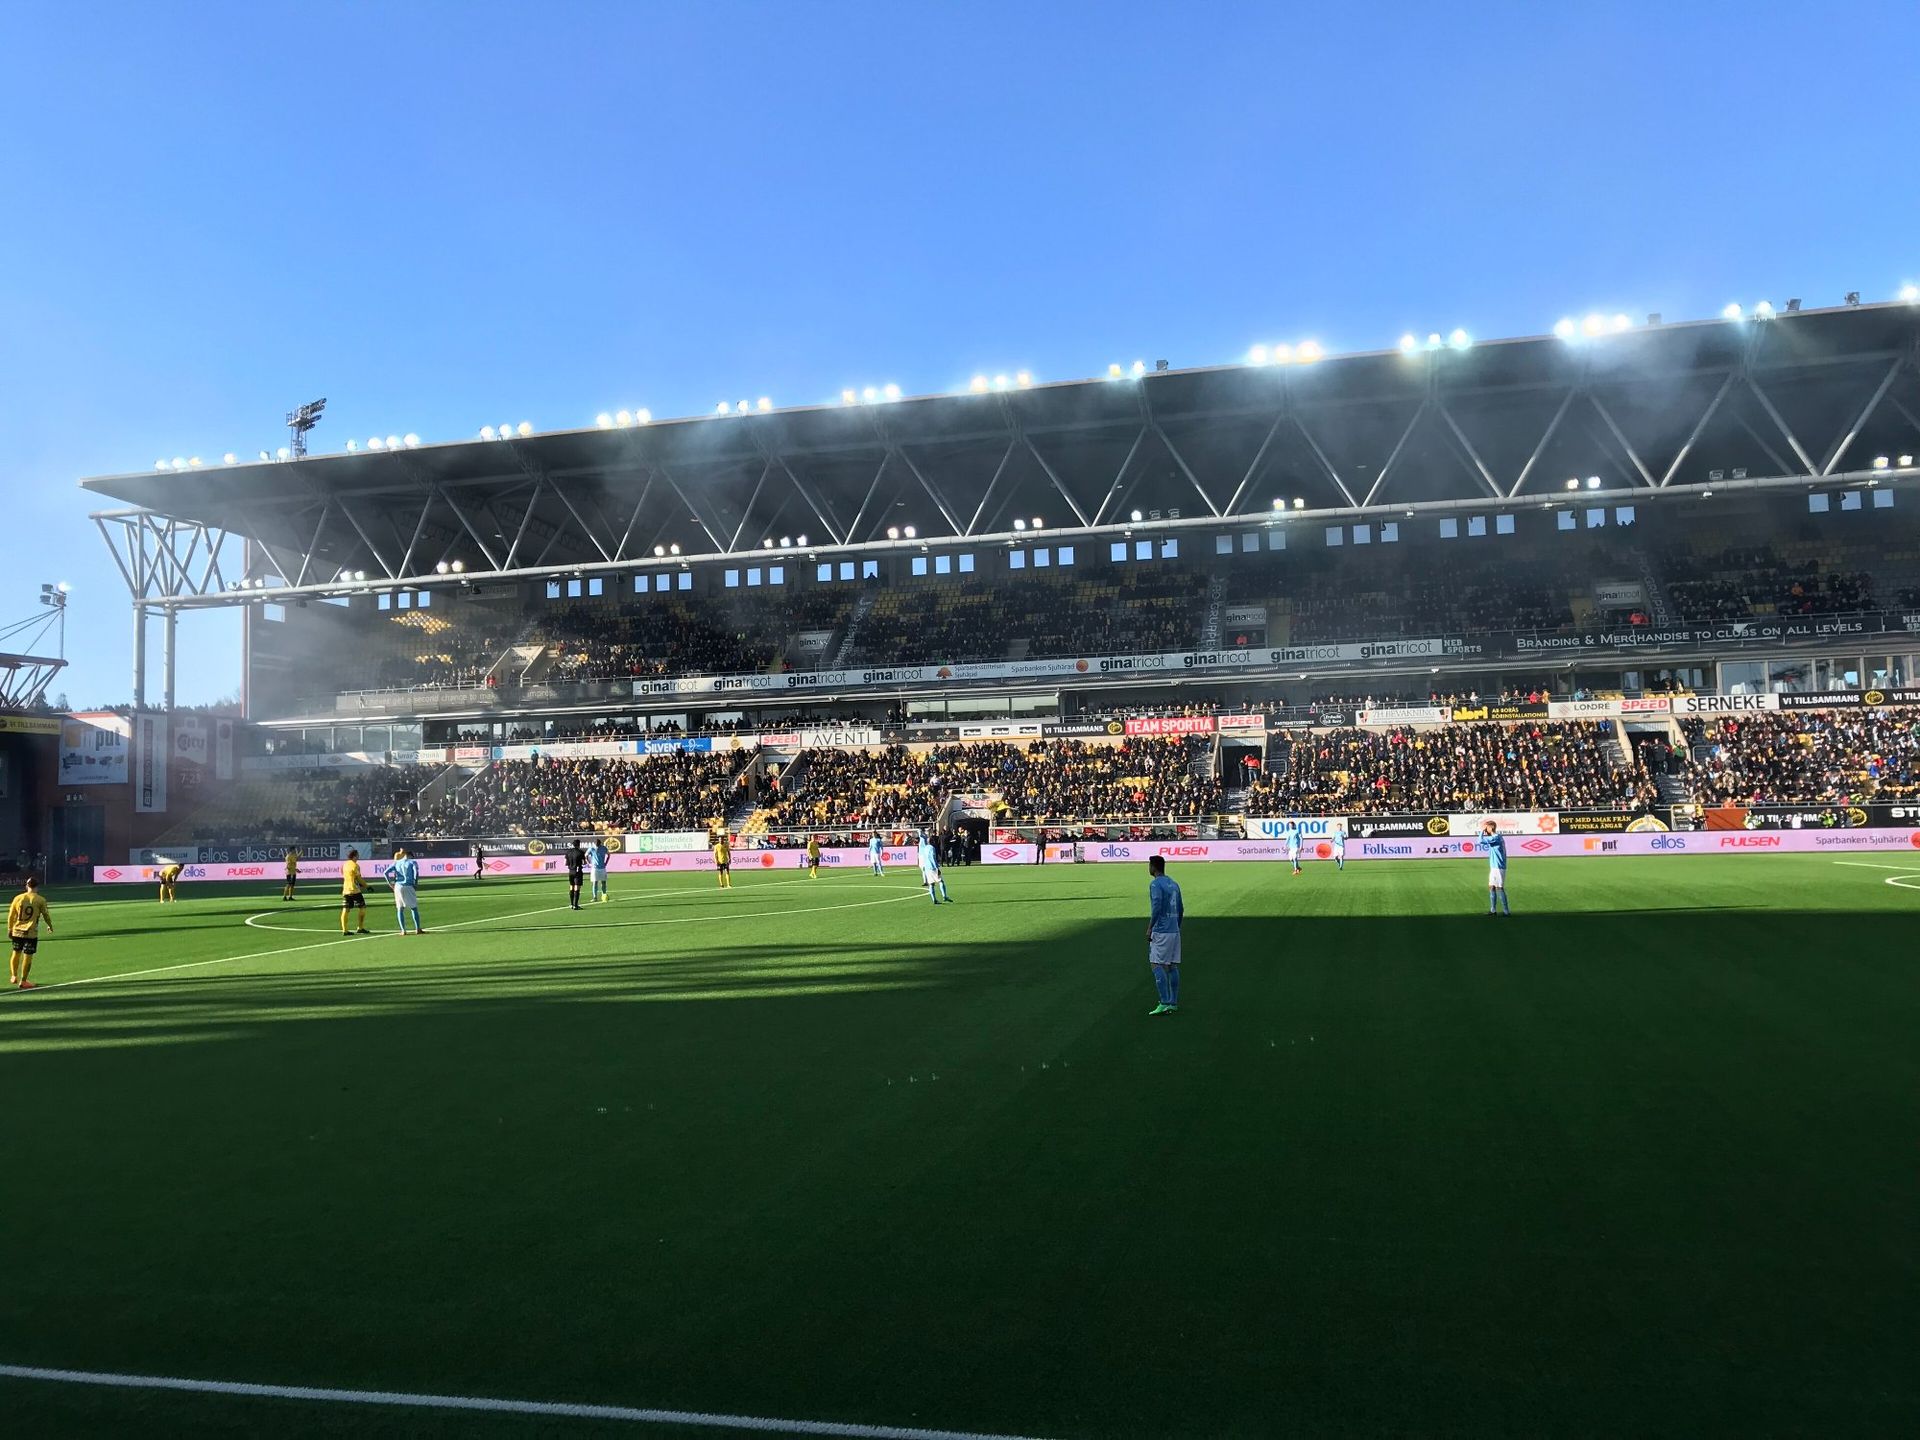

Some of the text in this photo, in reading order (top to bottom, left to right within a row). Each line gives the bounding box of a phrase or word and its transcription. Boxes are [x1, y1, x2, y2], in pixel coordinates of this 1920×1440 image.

[1517, 637, 1579, 649] BRANDING
[1586, 636, 1594, 645] &
[1600, 630, 1689, 645] MERCHANDISE
[1694, 631, 1711, 640] TO
[1762, 627, 1782, 636] ON
[1787, 625, 1810, 635] ALL
[1816, 622, 1862, 634] LEVELS
[1271, 646, 1340, 664] ginatricot
[1360, 641, 1431, 658] ginatricot
[1447, 645, 1481, 654] SPORTS
[1100, 655, 1165, 671] ginatricot
[1184, 650, 1251, 668] ginatricot
[788, 672, 846, 688] ginatricot
[863, 667, 923, 683] ginatricot
[641, 679, 697, 695] ginatricot
[714, 675, 771, 691] ginatricot
[1687, 695, 1765, 712] SERNEKE
[1782, 694, 1860, 705] VI TILLSAMMANS
[1892, 693, 1902, 701] VI
[1574, 702, 1610, 711] LONDRÉ
[1621, 699, 1668, 710] SPEED
[1126, 718, 1213, 732] TEAM SPORTIA
[1220, 715, 1262, 726] SPEED
[1053, 725, 1104, 733] TILLSAMMANS
[763, 734, 798, 744] SPEED
[813, 732, 870, 745] AVENTI
[457, 748, 489, 757] SPEED
[644, 739, 682, 753] SILVENT
[1351, 823, 1361, 831] VI
[1362, 822, 1424, 832] TILLSAMMANS
[546, 842, 553, 850] VI
[1651, 834, 1686, 849] ellos
[1721, 836, 1780, 847] PULSEN
[1816, 834, 1909, 848] Sparbanken Sjuhärad
[200, 847, 229, 862] ellos
[238, 845, 267, 862] ellos
[1101, 844, 1130, 857] ellos
[1159, 846, 1208, 856] PULSEN
[1237, 846, 1280, 856] Sparbanken
[1363, 843, 1412, 854] Folksam
[629, 857, 671, 867] PULSEN
[184, 865, 206, 877] ellos
[227, 867, 264, 877] PULSEN
[19, 905, 34, 922] 19
